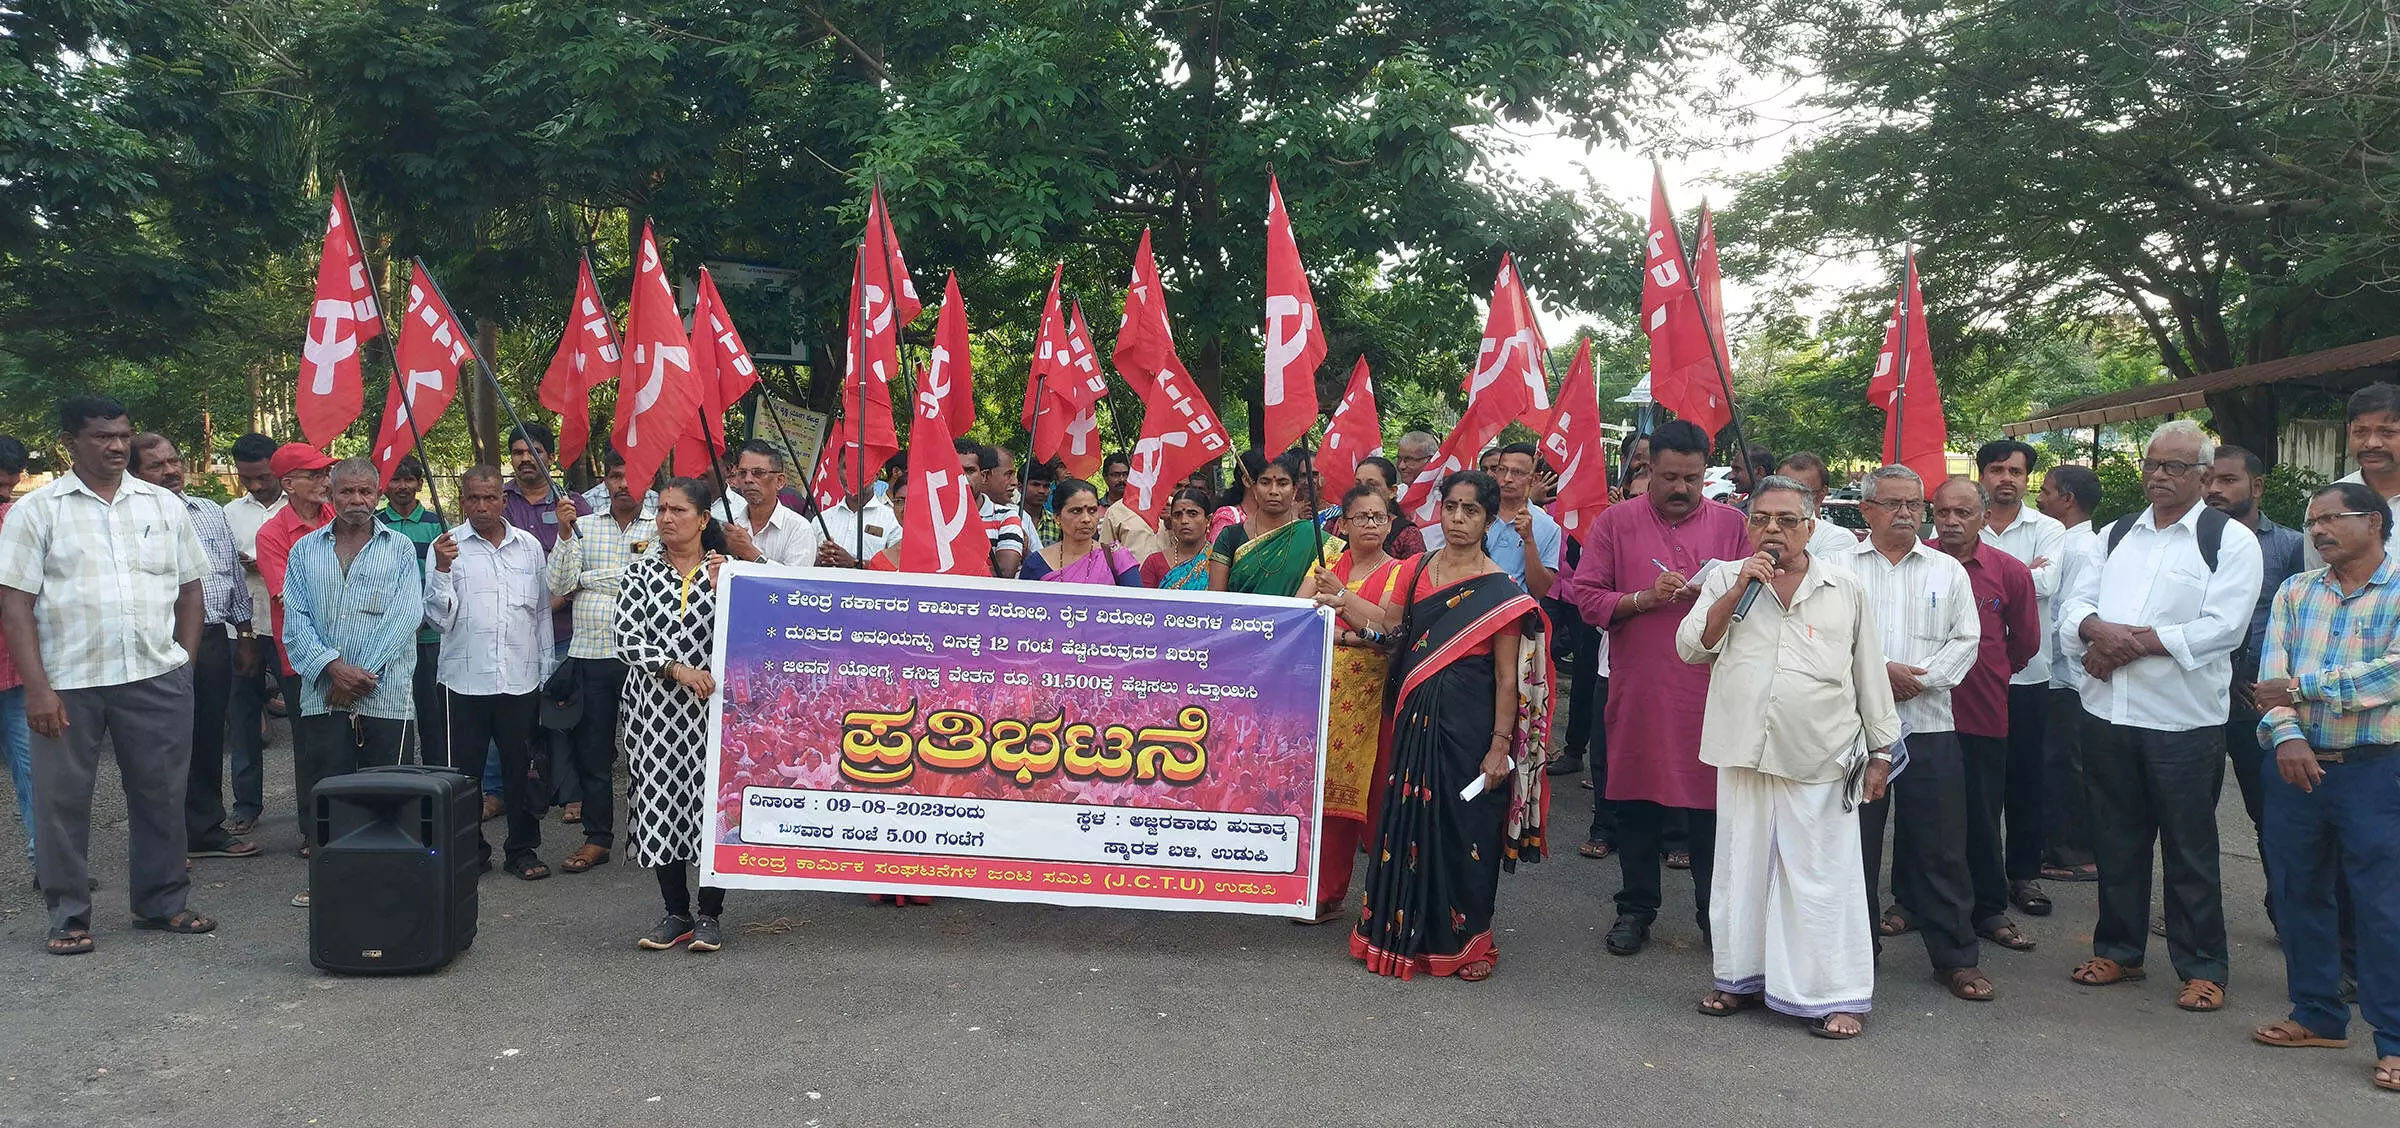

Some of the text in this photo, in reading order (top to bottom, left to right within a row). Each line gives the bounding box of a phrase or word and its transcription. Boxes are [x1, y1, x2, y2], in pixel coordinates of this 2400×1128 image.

[788, 590, 832, 612] ಕೇಂದ್ರ
[841, 595, 909, 612] ಸರ್ಕಾರದ
[918, 600, 980, 616] ಕಾರ್ಮಿಕ
[1060, 605, 1088, 628] ರೈತ
[1096, 609, 1155, 628] ವಿರೋಧಿ
[1164, 613, 1222, 630] ನೀತಿಗಳ
[1231, 618, 1275, 640] ವಿರುದ್ಧ
[785, 625, 1209, 670] ದುಡಿತದ ಅವಧಿಯನ್ನು ದಿನಕ್ಕೆ 12 ಗಂಟೆ ಹೆಚ್ಚಿಸಿರುವುದರ ವಿರುದ್ಧ
[783, 659, 830, 675] ಜೀವನ
[838, 661, 894, 685] ಯೋಗ್ಯ
[948, 667, 995, 684] ವೇತನ
[1003, 670, 1033, 686] ರೂ.
[1121, 676, 1178, 699] ಹೆಚ್ಚಿಸಲು
[1186, 681, 1259, 702] ಒತ್ತಾಯಿಸಿ
[839, 698, 1209, 786] ಪ್ರತಿಭಟನೆ
[750, 792, 806, 809] ದಿನಾಂಕ
[826, 797, 986, 819] 09-08-2023ರಂದು
[1076, 809, 1106, 832] ಸ್ಥಳ
[1129, 814, 1218, 837] ಅಜ್ಜರಕಾಡು
[1227, 818, 1288, 841] ಹುತಾತ್ಮ
[842, 826, 879, 842] ಸಂಜೆ
[886, 829, 927, 844] 5.00
[935, 831, 985, 848] ಗಂಟೆಗೆ
[1104, 840, 1158, 861] ಸ್ಮಾರಕ
[1211, 847, 1269, 863] ಉಡುಪಿ
[738, 853, 1277, 896] ಕೇಂದ್ರ ಕಾರ್ಮಿಕ ಸಂಘಟನೆಗಳ ಜಂಟಿ ಸಮಿತಿ (J.C.T.U) ಉಡುಪಿ
